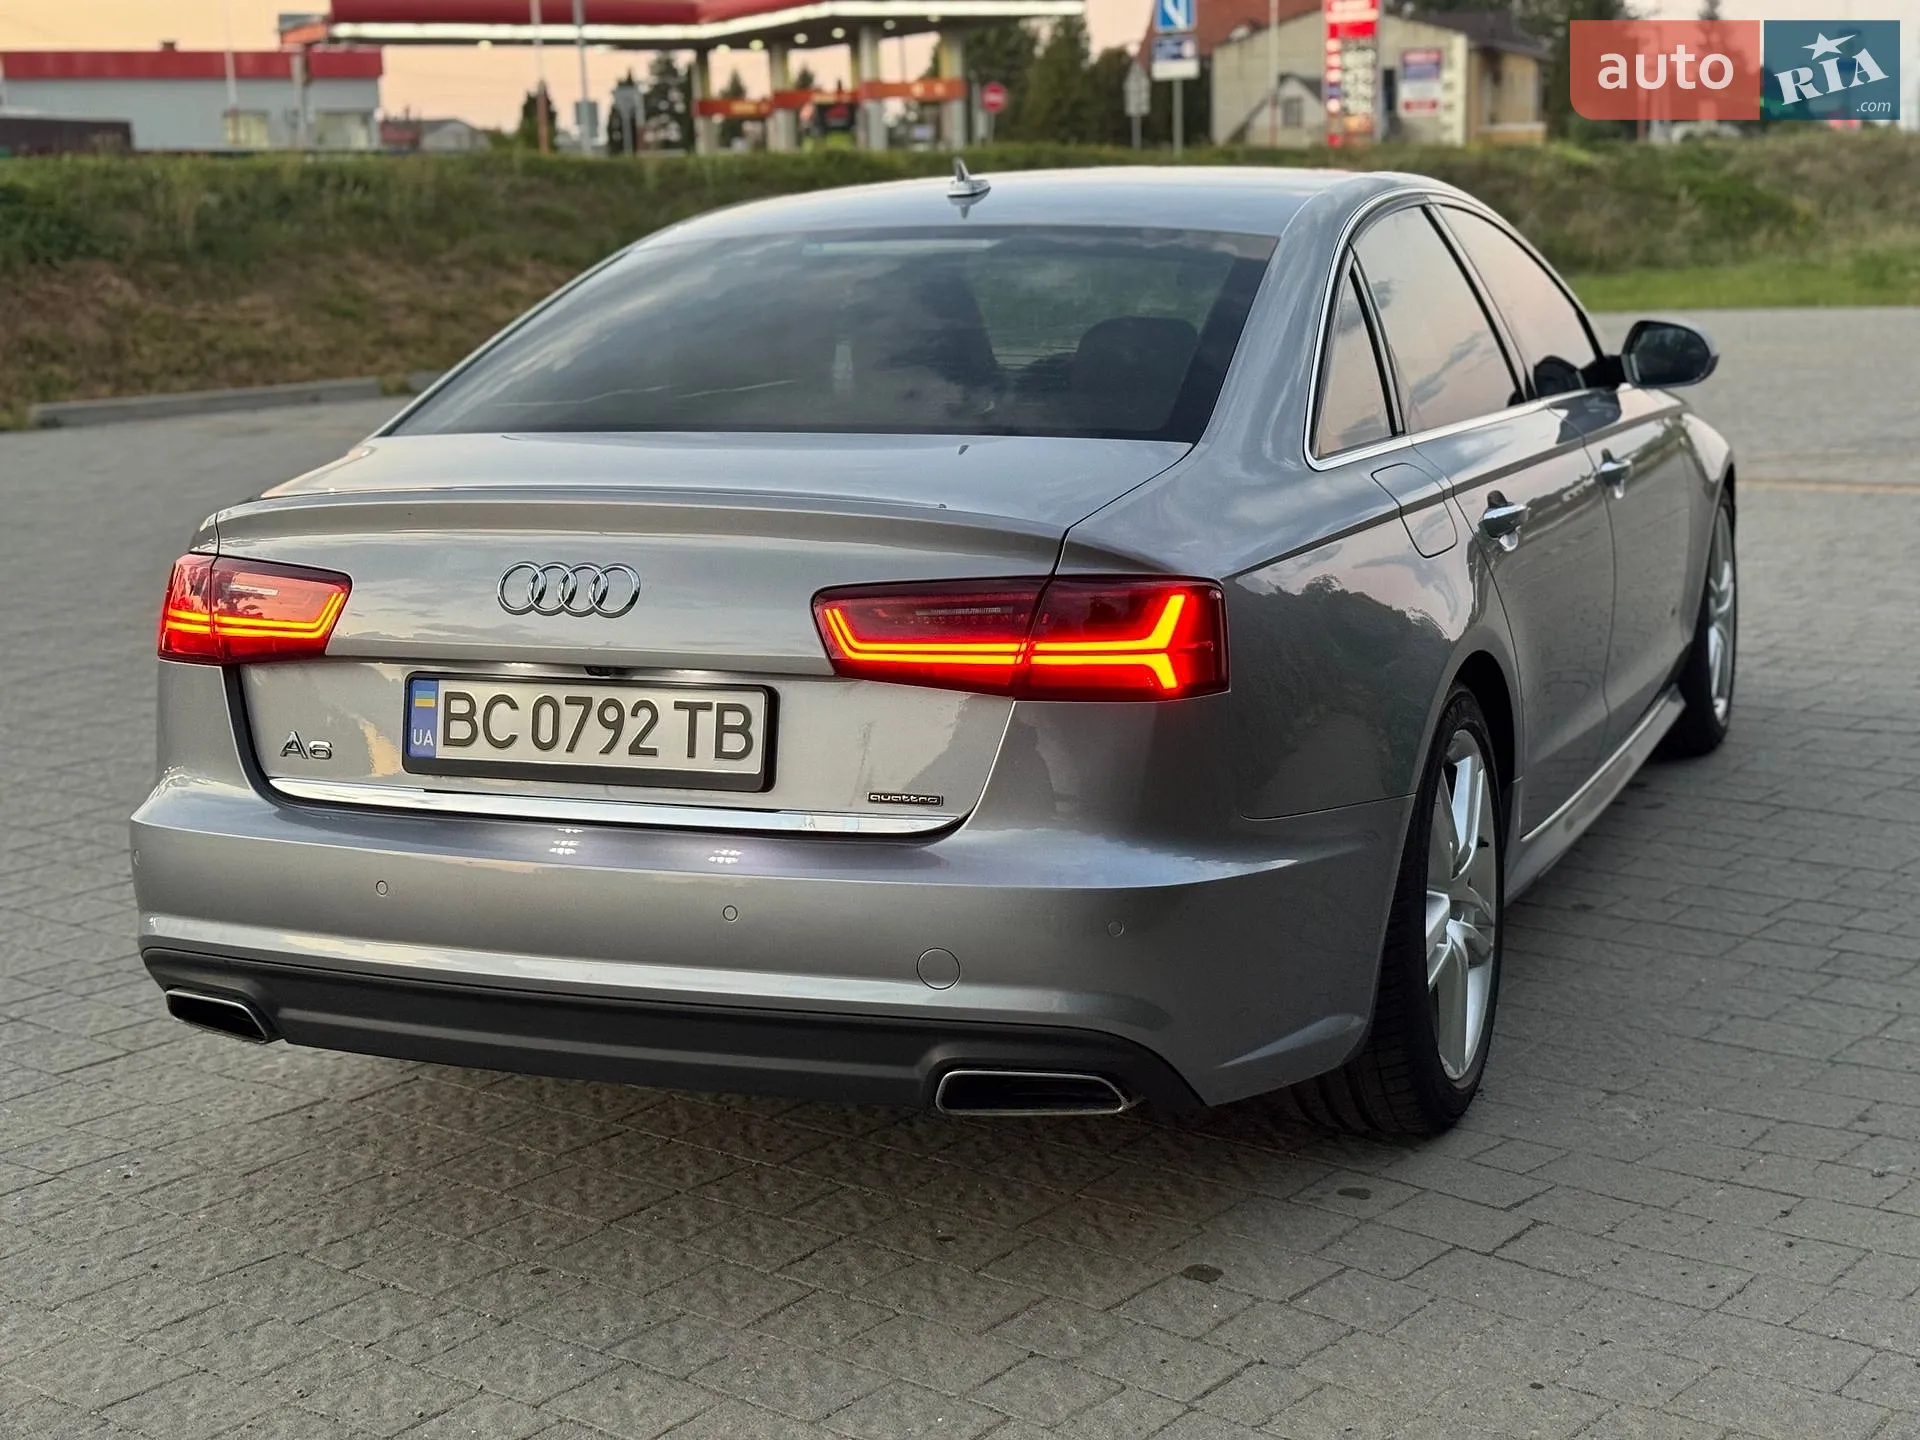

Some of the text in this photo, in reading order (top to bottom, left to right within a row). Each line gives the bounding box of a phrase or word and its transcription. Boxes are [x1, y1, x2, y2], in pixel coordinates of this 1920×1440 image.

[443, 690, 753, 760] BC 0792 TB
[280, 730, 332, 760] A6
[413, 729, 434, 747] UA
[869, 793, 939, 804] quattro
